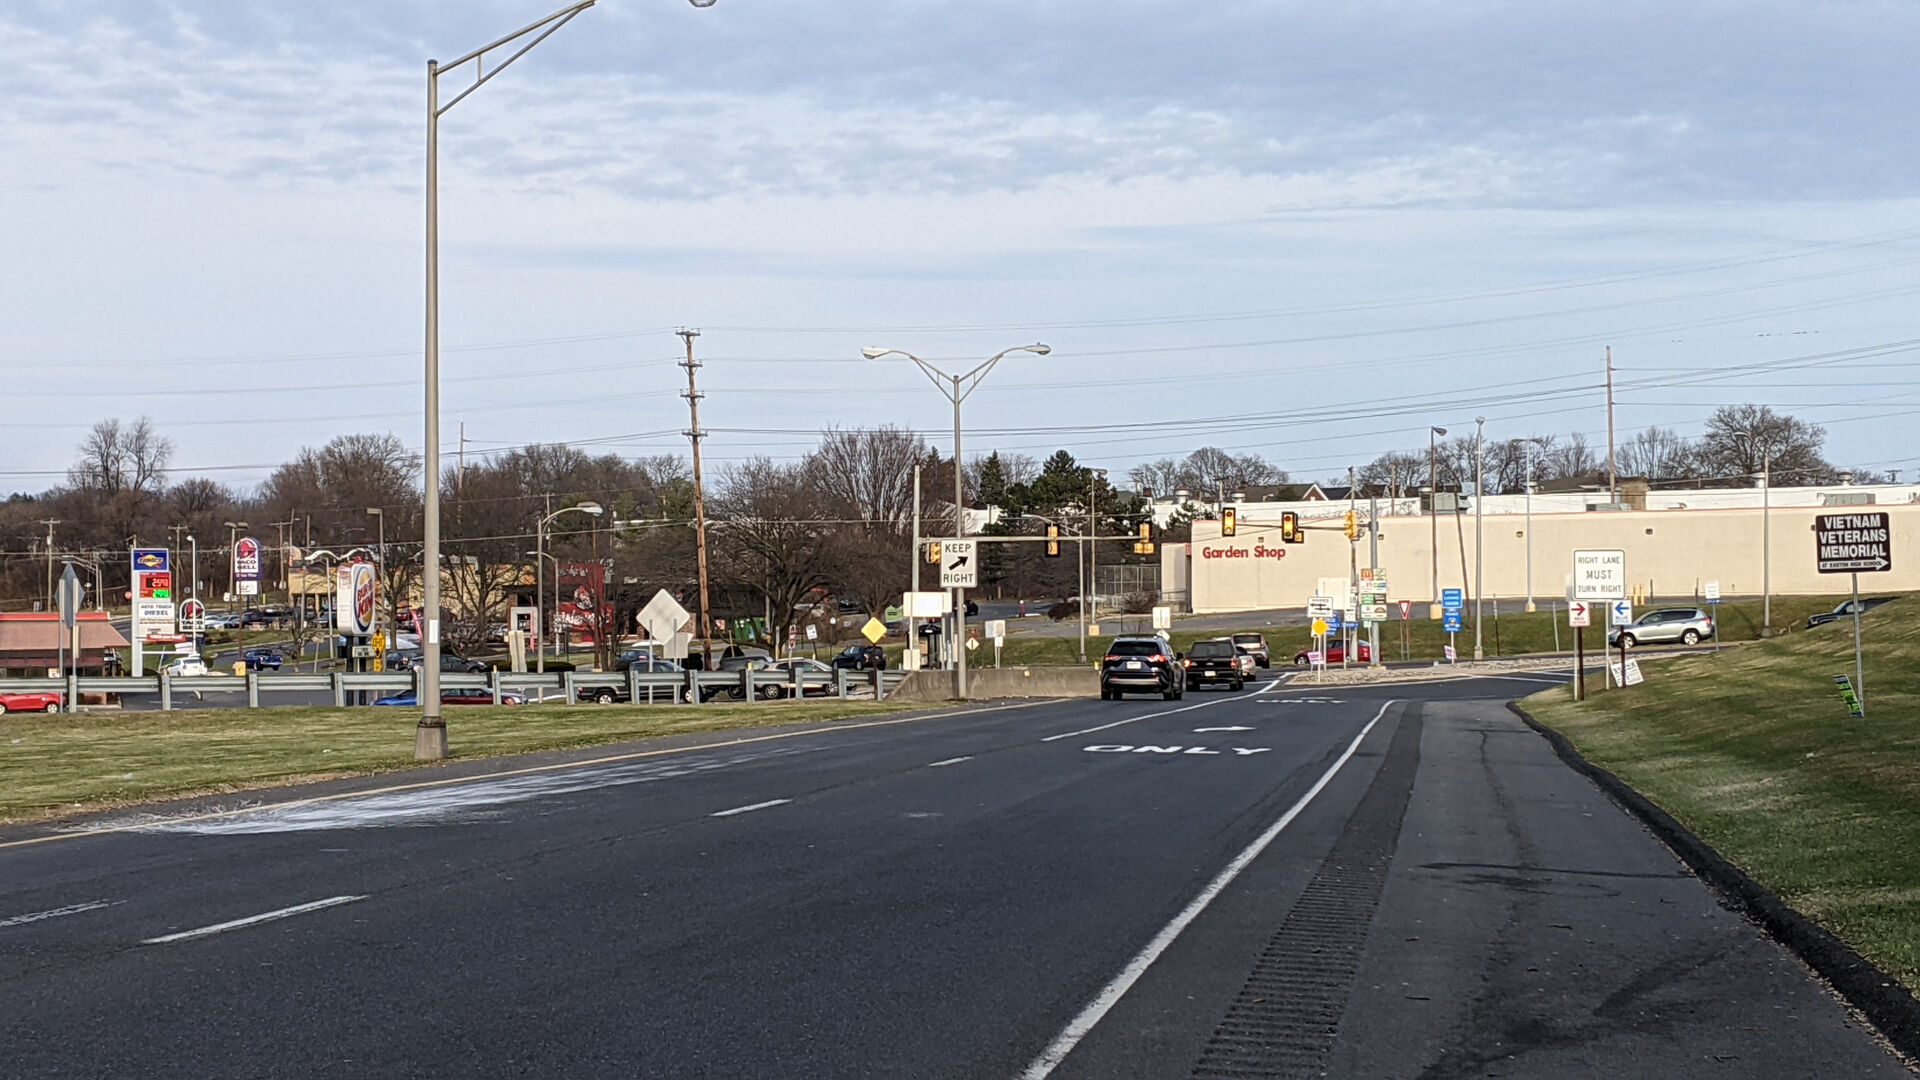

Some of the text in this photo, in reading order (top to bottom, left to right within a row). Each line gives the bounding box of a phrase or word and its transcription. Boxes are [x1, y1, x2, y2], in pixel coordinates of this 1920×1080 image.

[1823, 514, 1881, 529] VIETNAM
[1819, 529, 1887, 544] VETERANS
[945, 543, 971, 553] KEEP
[1202, 545, 1286, 561] Garden Shop
[1821, 543, 1887, 559] MEMORIAL
[1578, 556, 1621, 564] RIGHT LANE
[943, 573, 974, 583] RIGHT
[1586, 569, 1612, 580] MUST
[1578, 585, 1622, 593] TURN RIGHT
[1082, 745, 1273, 755] ONLY
